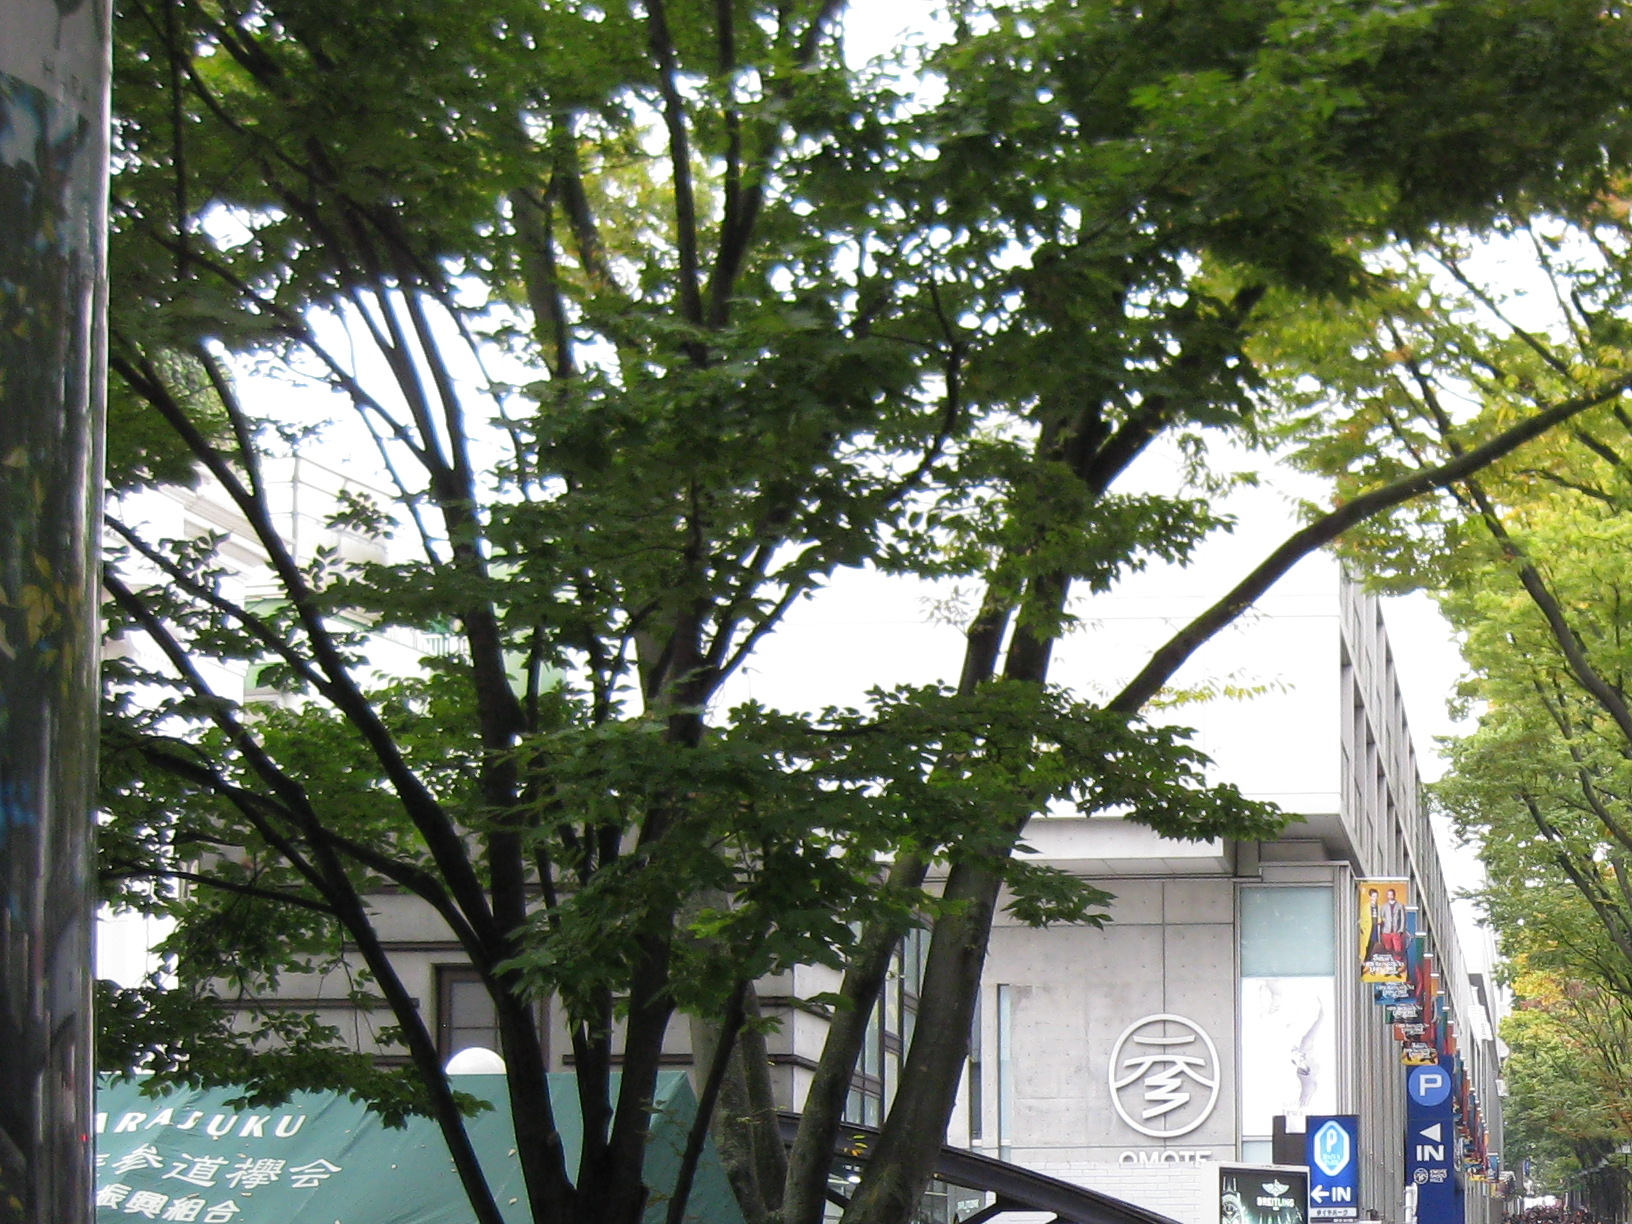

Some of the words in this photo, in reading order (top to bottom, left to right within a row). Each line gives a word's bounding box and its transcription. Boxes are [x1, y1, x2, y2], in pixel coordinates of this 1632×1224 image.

[1419, 1074, 1442, 1096] P
[1416, 1144, 1445, 1161] IN
[1331, 1187, 1352, 1202] IN
